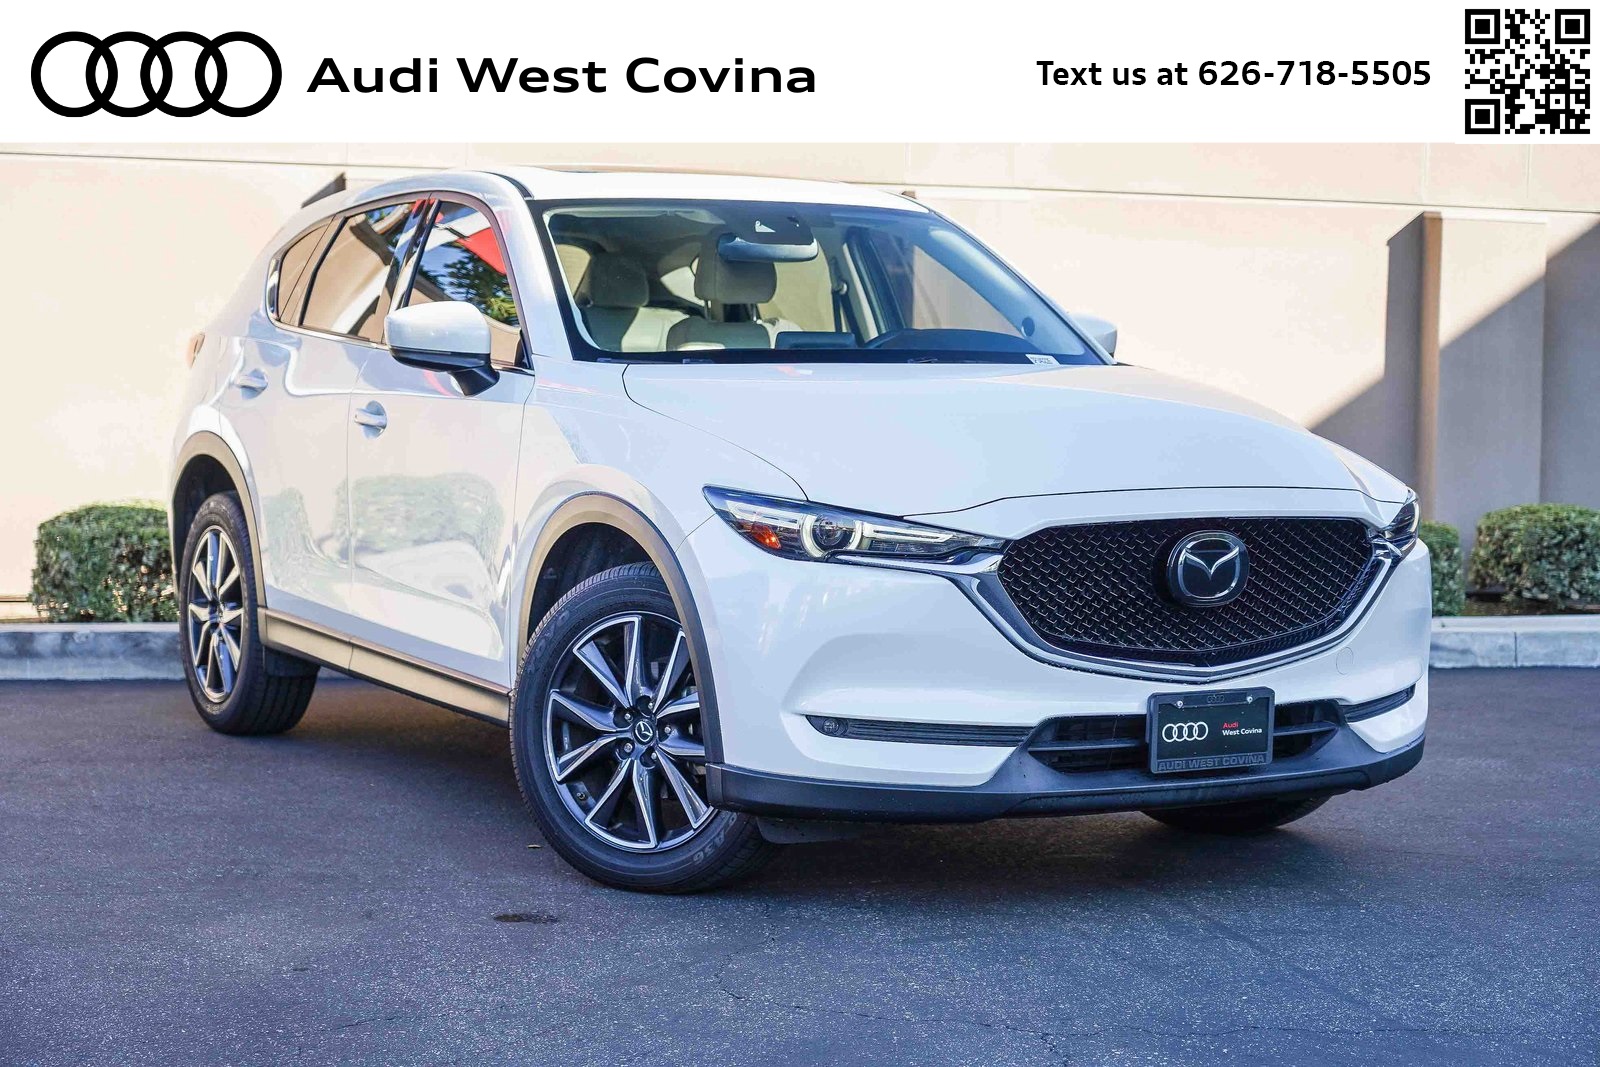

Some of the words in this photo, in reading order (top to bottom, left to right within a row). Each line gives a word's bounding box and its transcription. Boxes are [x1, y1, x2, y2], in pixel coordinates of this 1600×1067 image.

[1222, 721, 1239, 729] Audi
[1240, 727, 1263, 735] Covina
[1158, 760, 1186, 771] AUDI
[1186, 757, 1219, 769] WEST
[1222, 754, 1265, 766] COVINA
